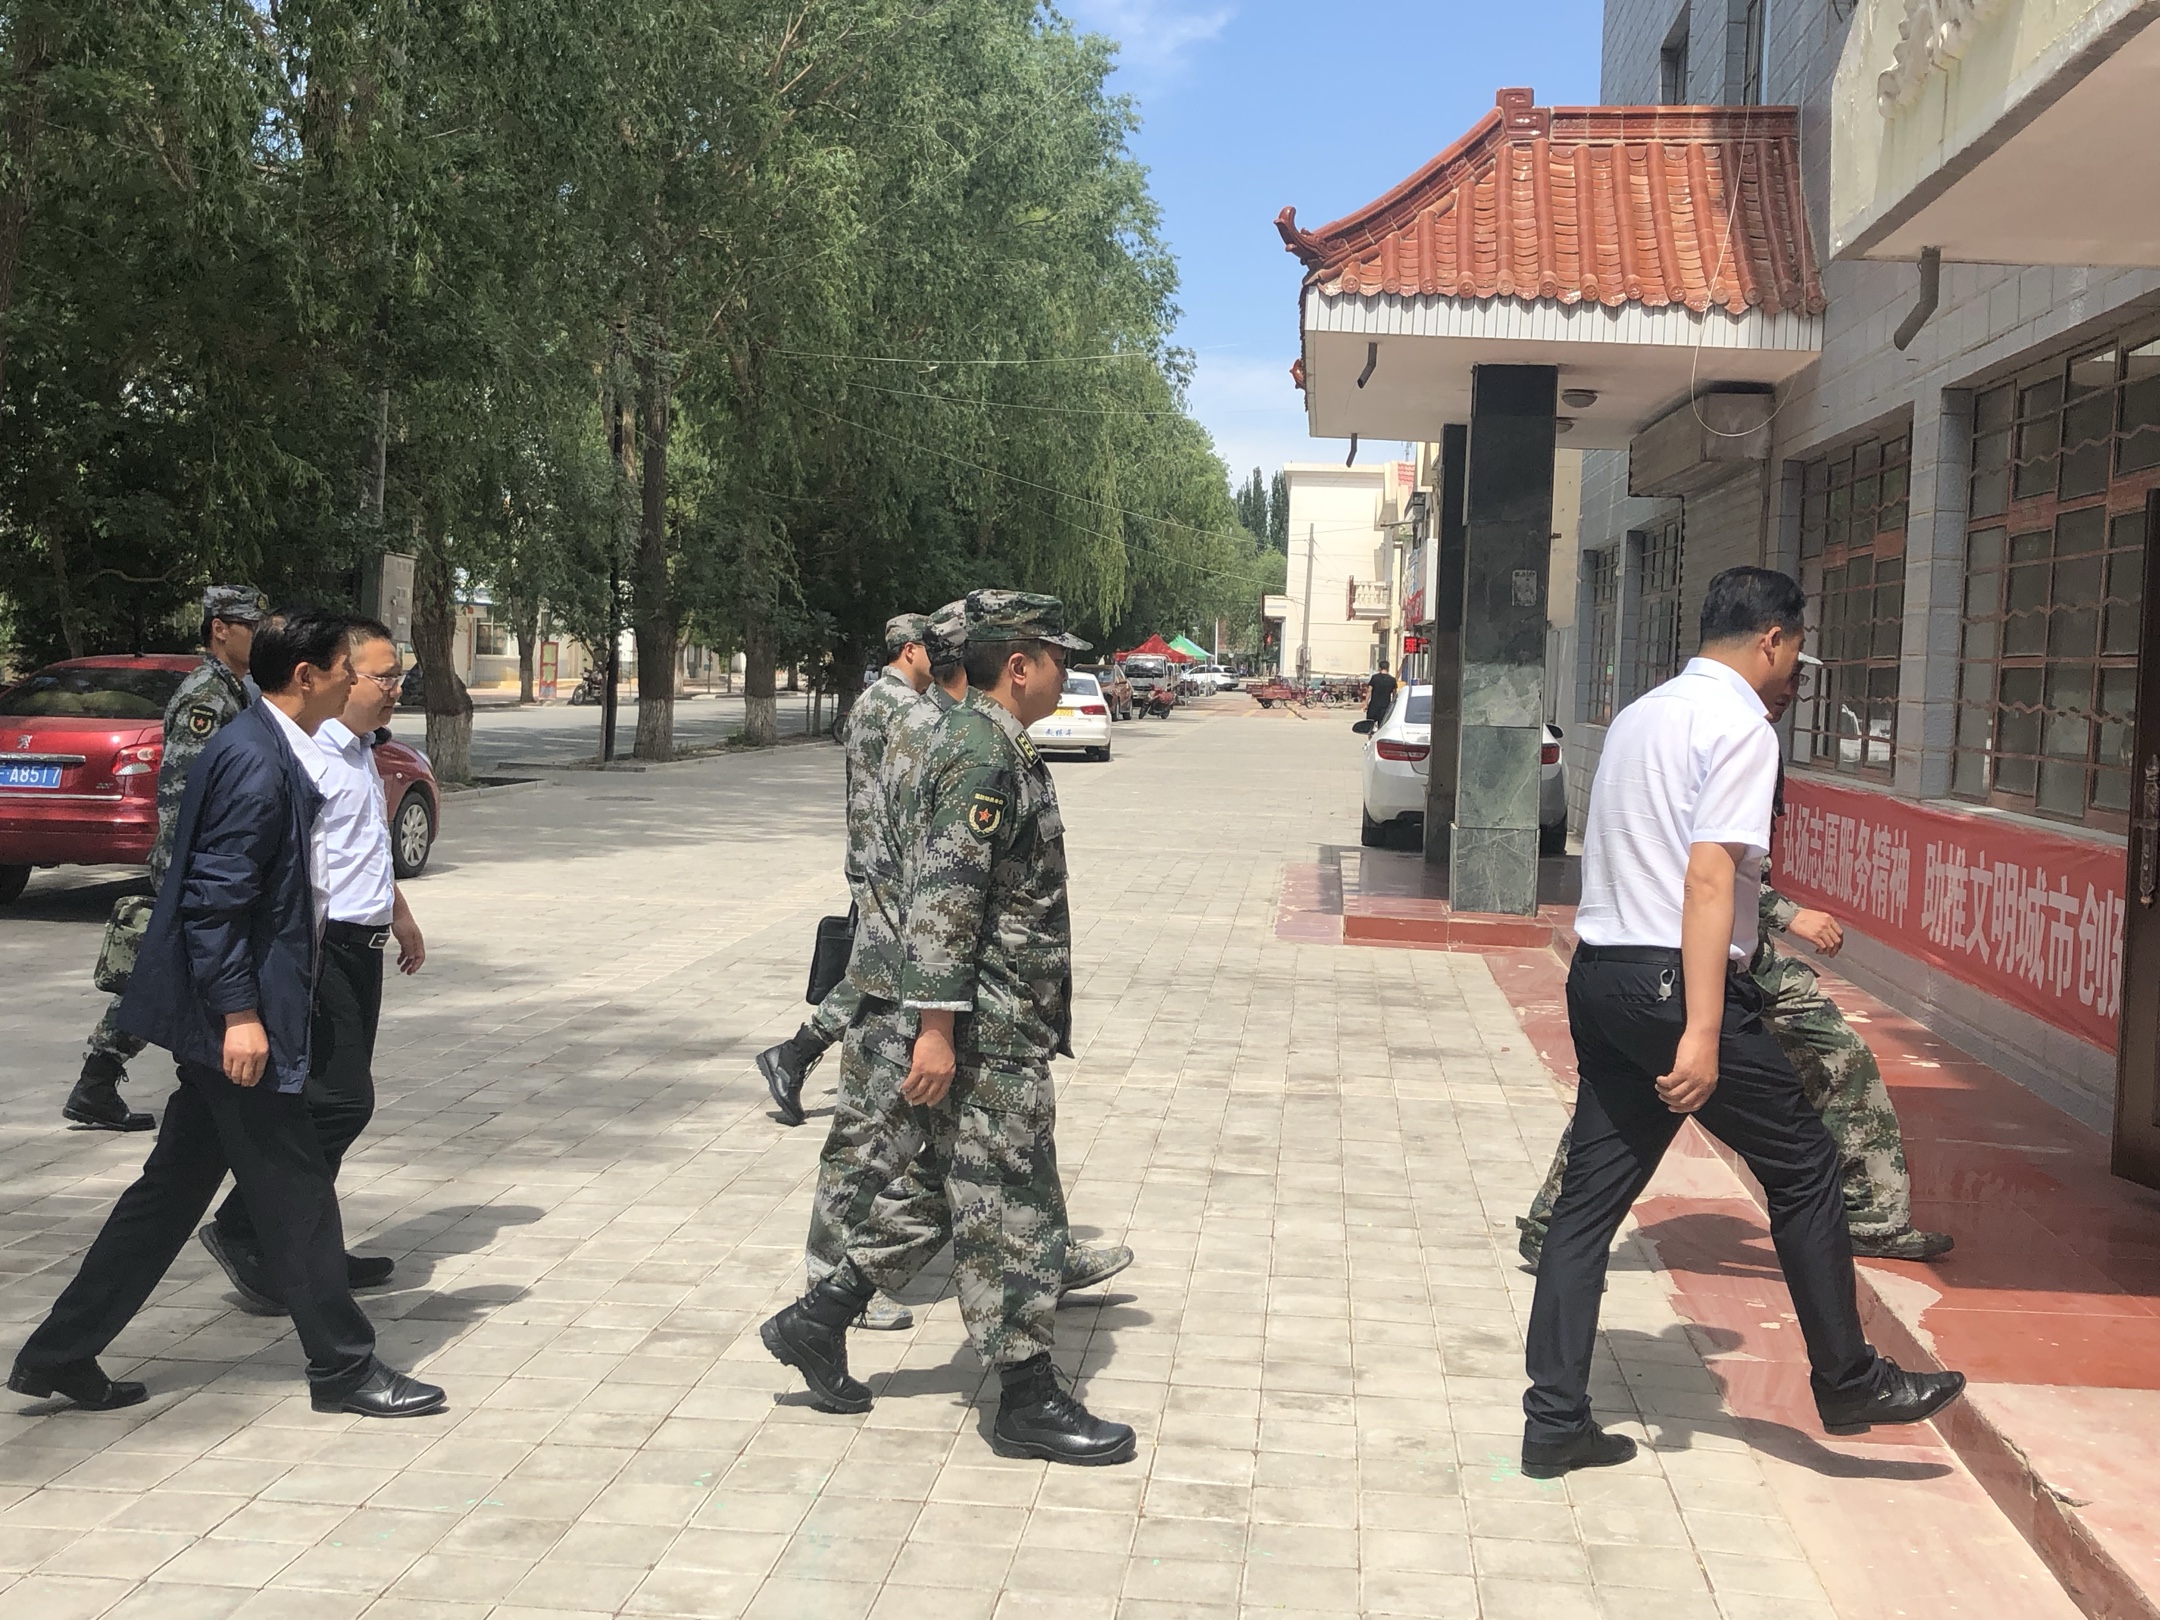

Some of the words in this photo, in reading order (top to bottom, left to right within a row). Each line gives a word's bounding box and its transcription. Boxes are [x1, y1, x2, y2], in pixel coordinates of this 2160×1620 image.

[1783, 803, 1910, 929] 弘扬志愿服务精神
